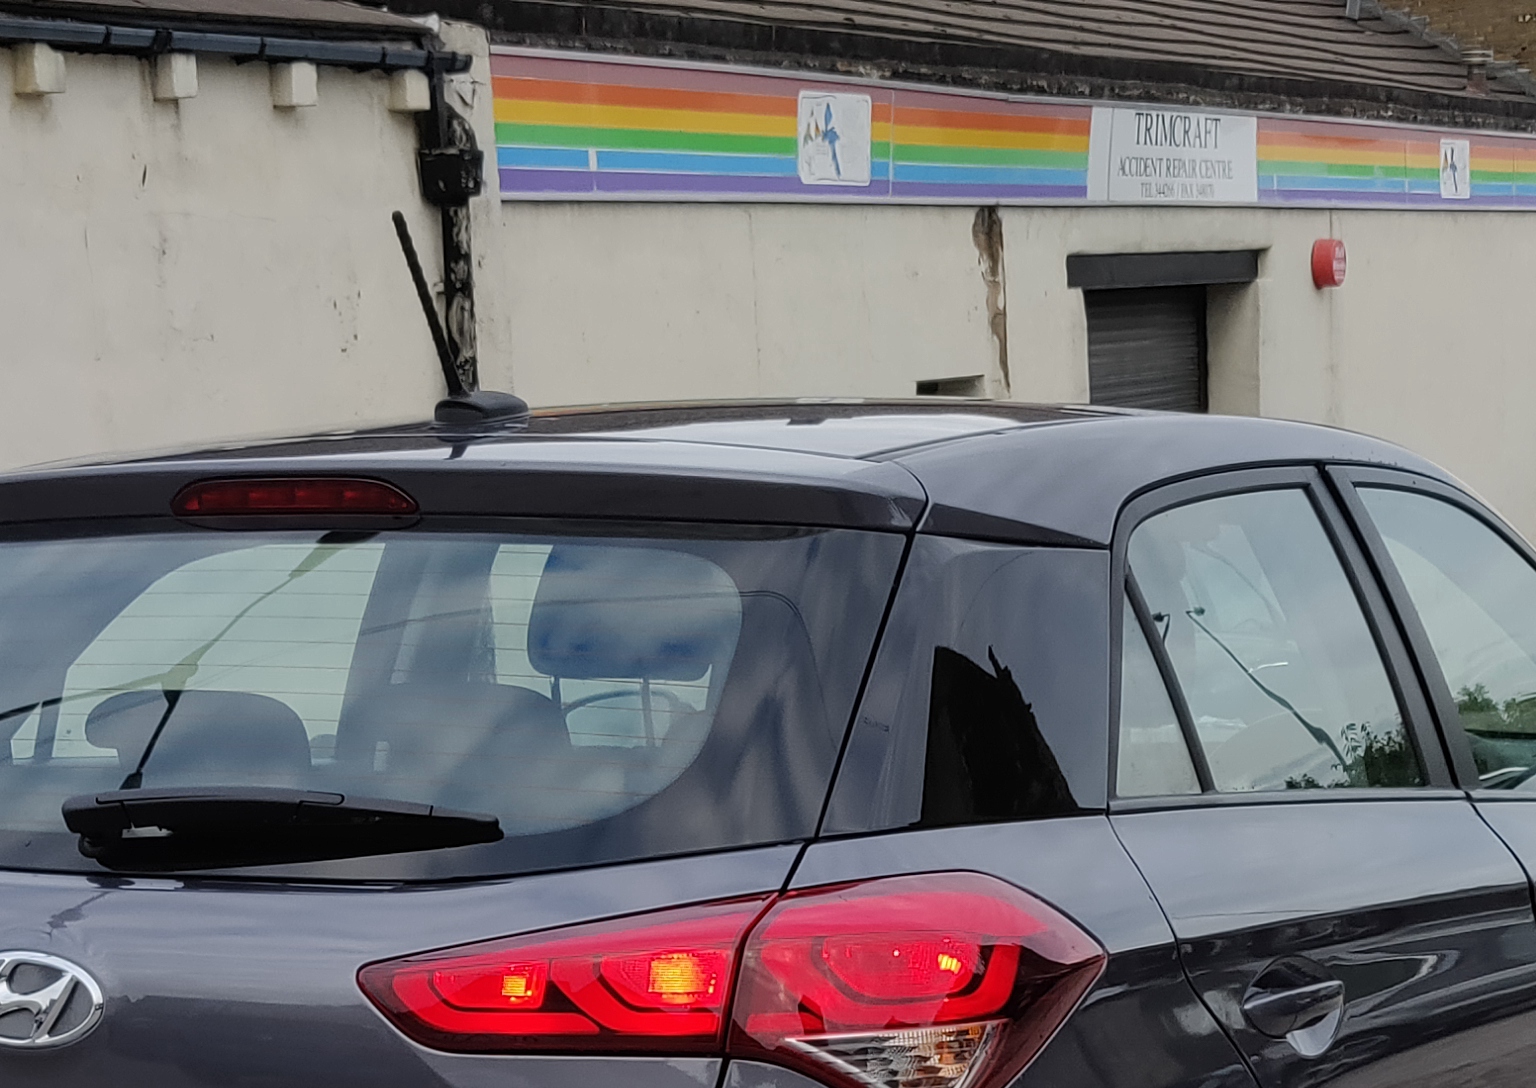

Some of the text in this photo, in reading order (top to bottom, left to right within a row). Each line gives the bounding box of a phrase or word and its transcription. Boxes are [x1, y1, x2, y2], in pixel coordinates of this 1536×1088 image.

[1135, 112, 1221, 149] TRIMCRAFT
[1118, 156, 1233, 179] ACCIDENT REPAIR CENTRE
